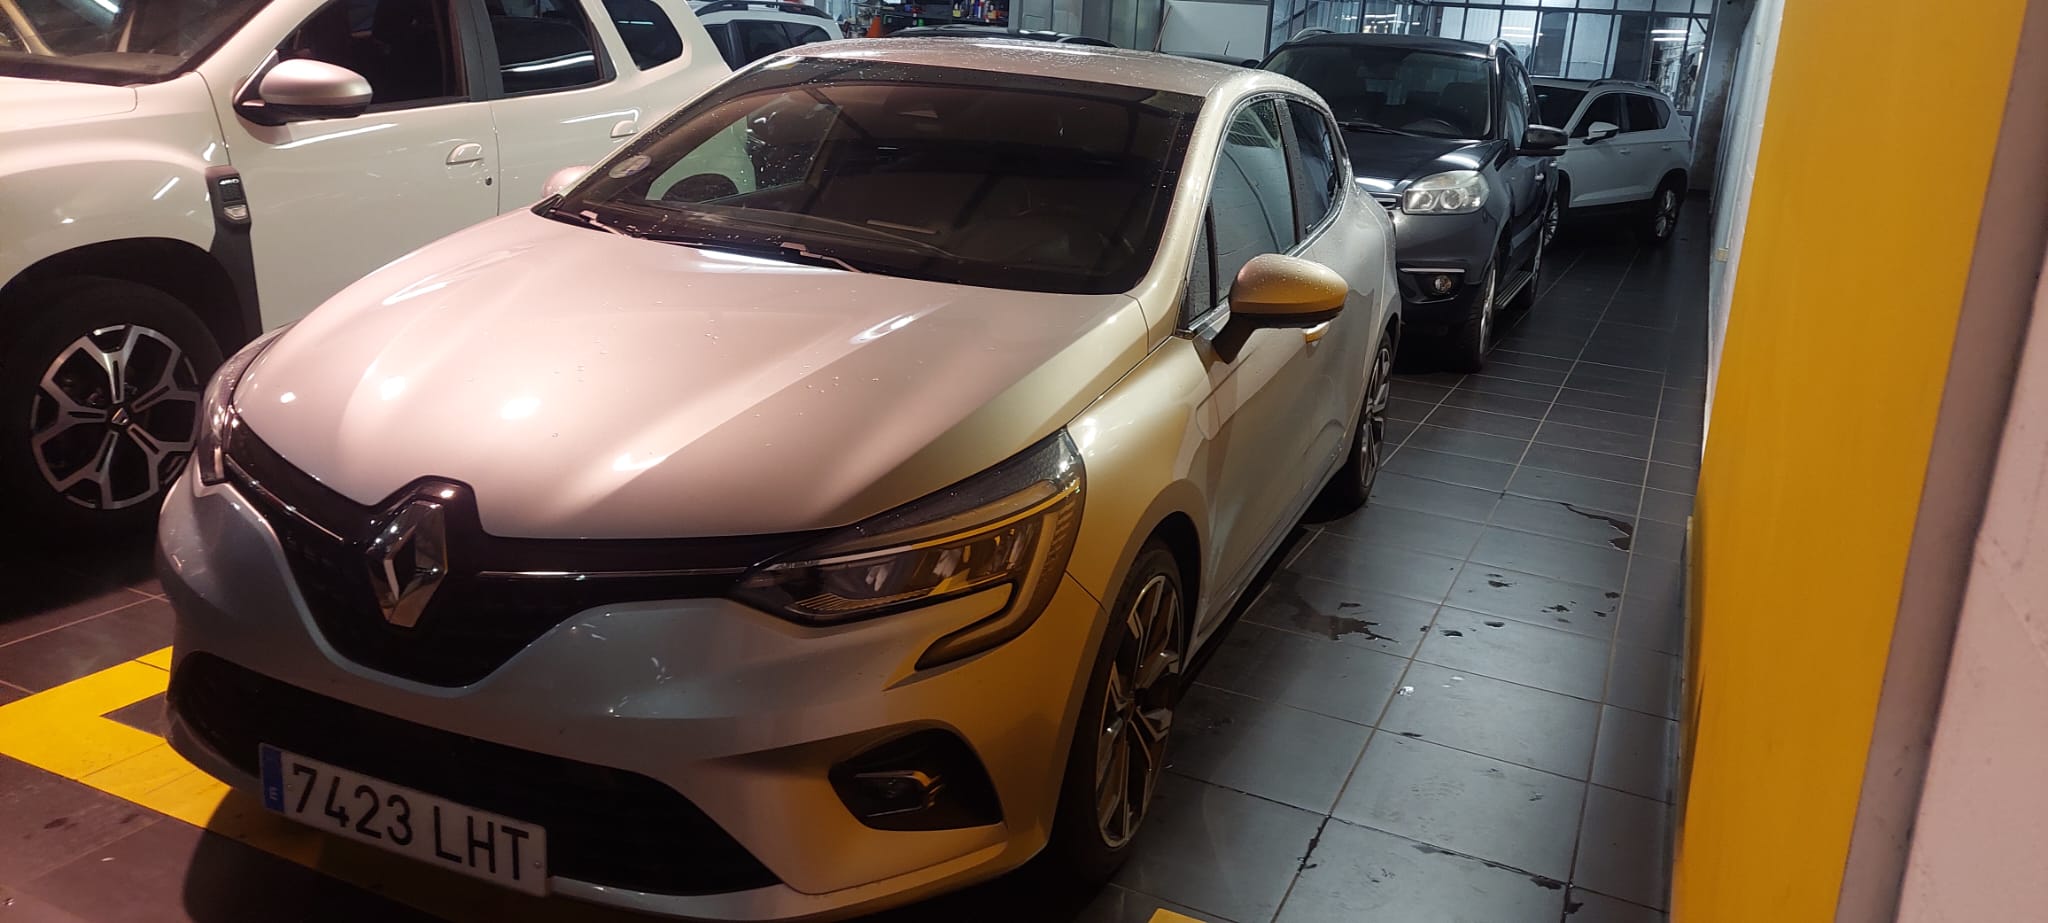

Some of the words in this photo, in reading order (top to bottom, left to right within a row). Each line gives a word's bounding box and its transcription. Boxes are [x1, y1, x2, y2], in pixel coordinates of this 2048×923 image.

[269, 785, 278, 801] E
[293, 763, 412, 846] 7423
[433, 805, 529, 881] LHT
